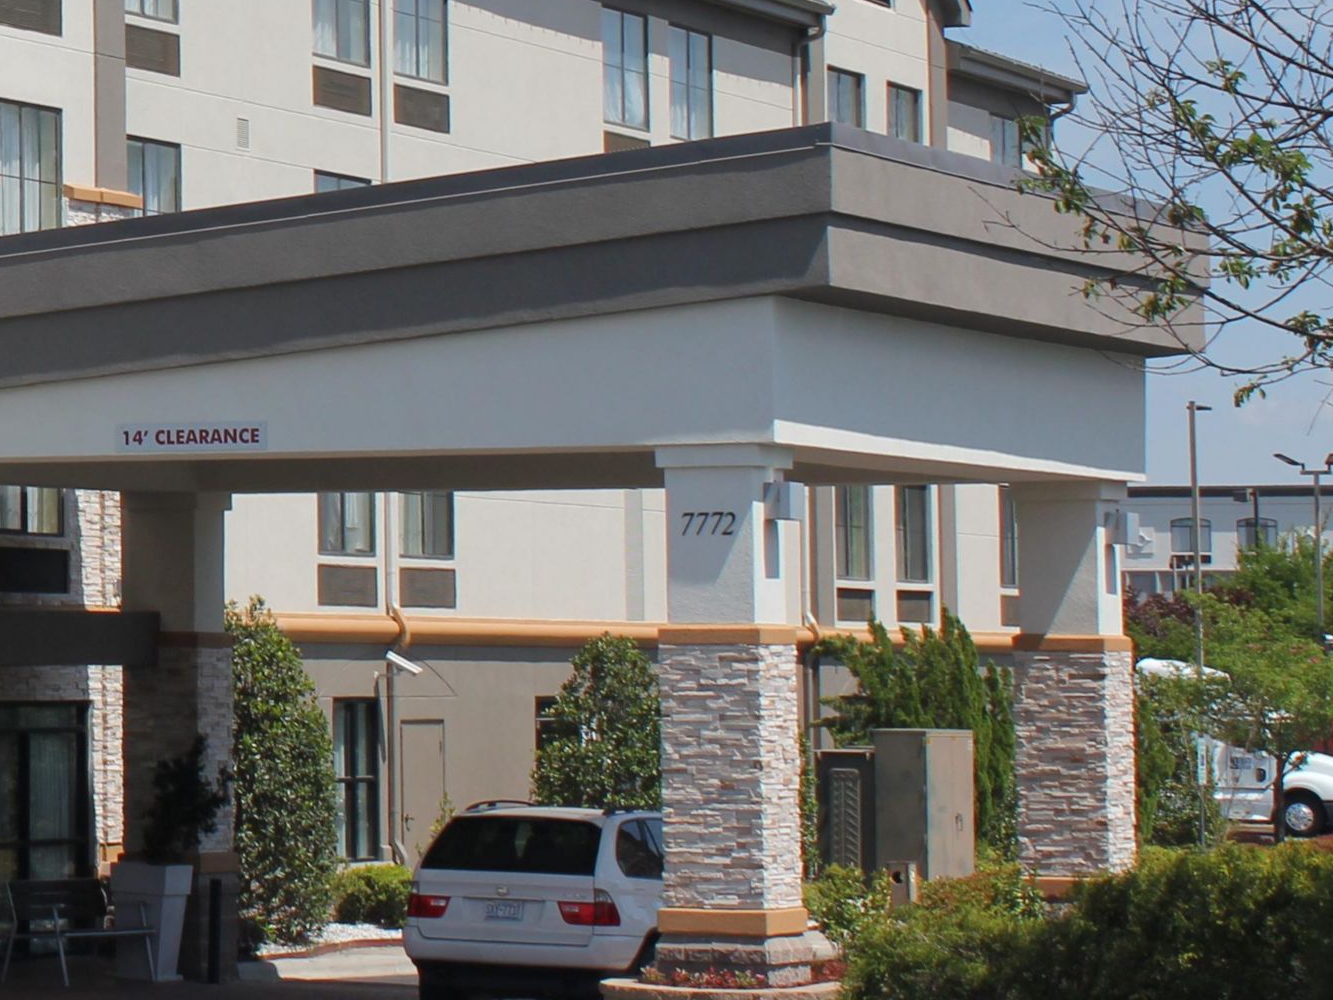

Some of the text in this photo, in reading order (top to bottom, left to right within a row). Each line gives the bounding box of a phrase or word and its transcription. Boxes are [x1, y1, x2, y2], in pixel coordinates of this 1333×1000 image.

[122, 428, 260, 446] 14' CLEARANCE
[681, 511, 736, 536] 7772
